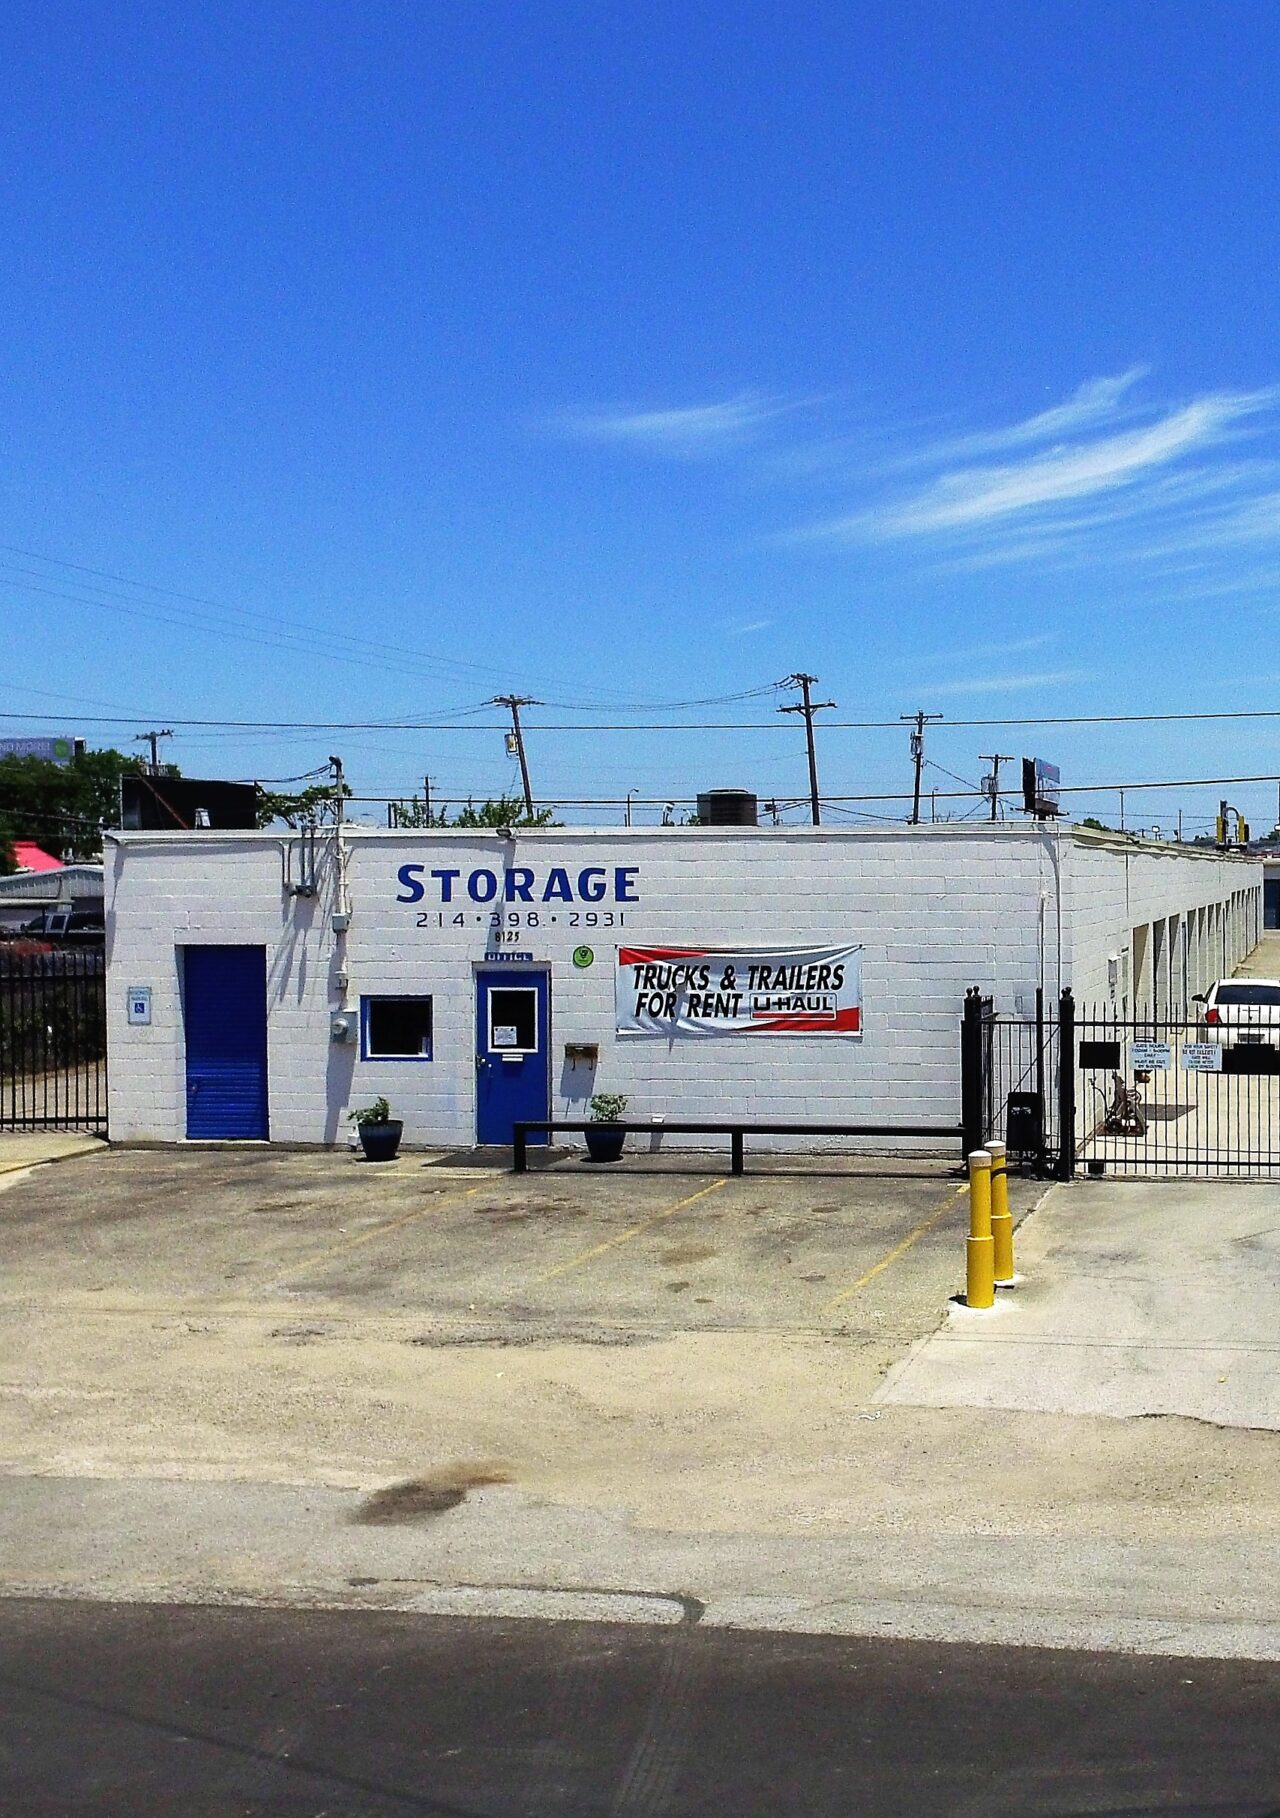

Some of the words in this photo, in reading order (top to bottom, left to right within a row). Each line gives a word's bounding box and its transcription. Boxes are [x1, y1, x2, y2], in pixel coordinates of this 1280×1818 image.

[396, 864, 640, 904] STORAGE
[494, 931, 520, 943] 8125
[633, 964, 711, 991] TRUCKS
[720, 964, 736, 991] &
[748, 964, 845, 991] TRAILERS
[634, 992, 677, 1018] FOR
[687, 992, 743, 1018] RENT
[753, 996, 834, 1011] U-HAUL
